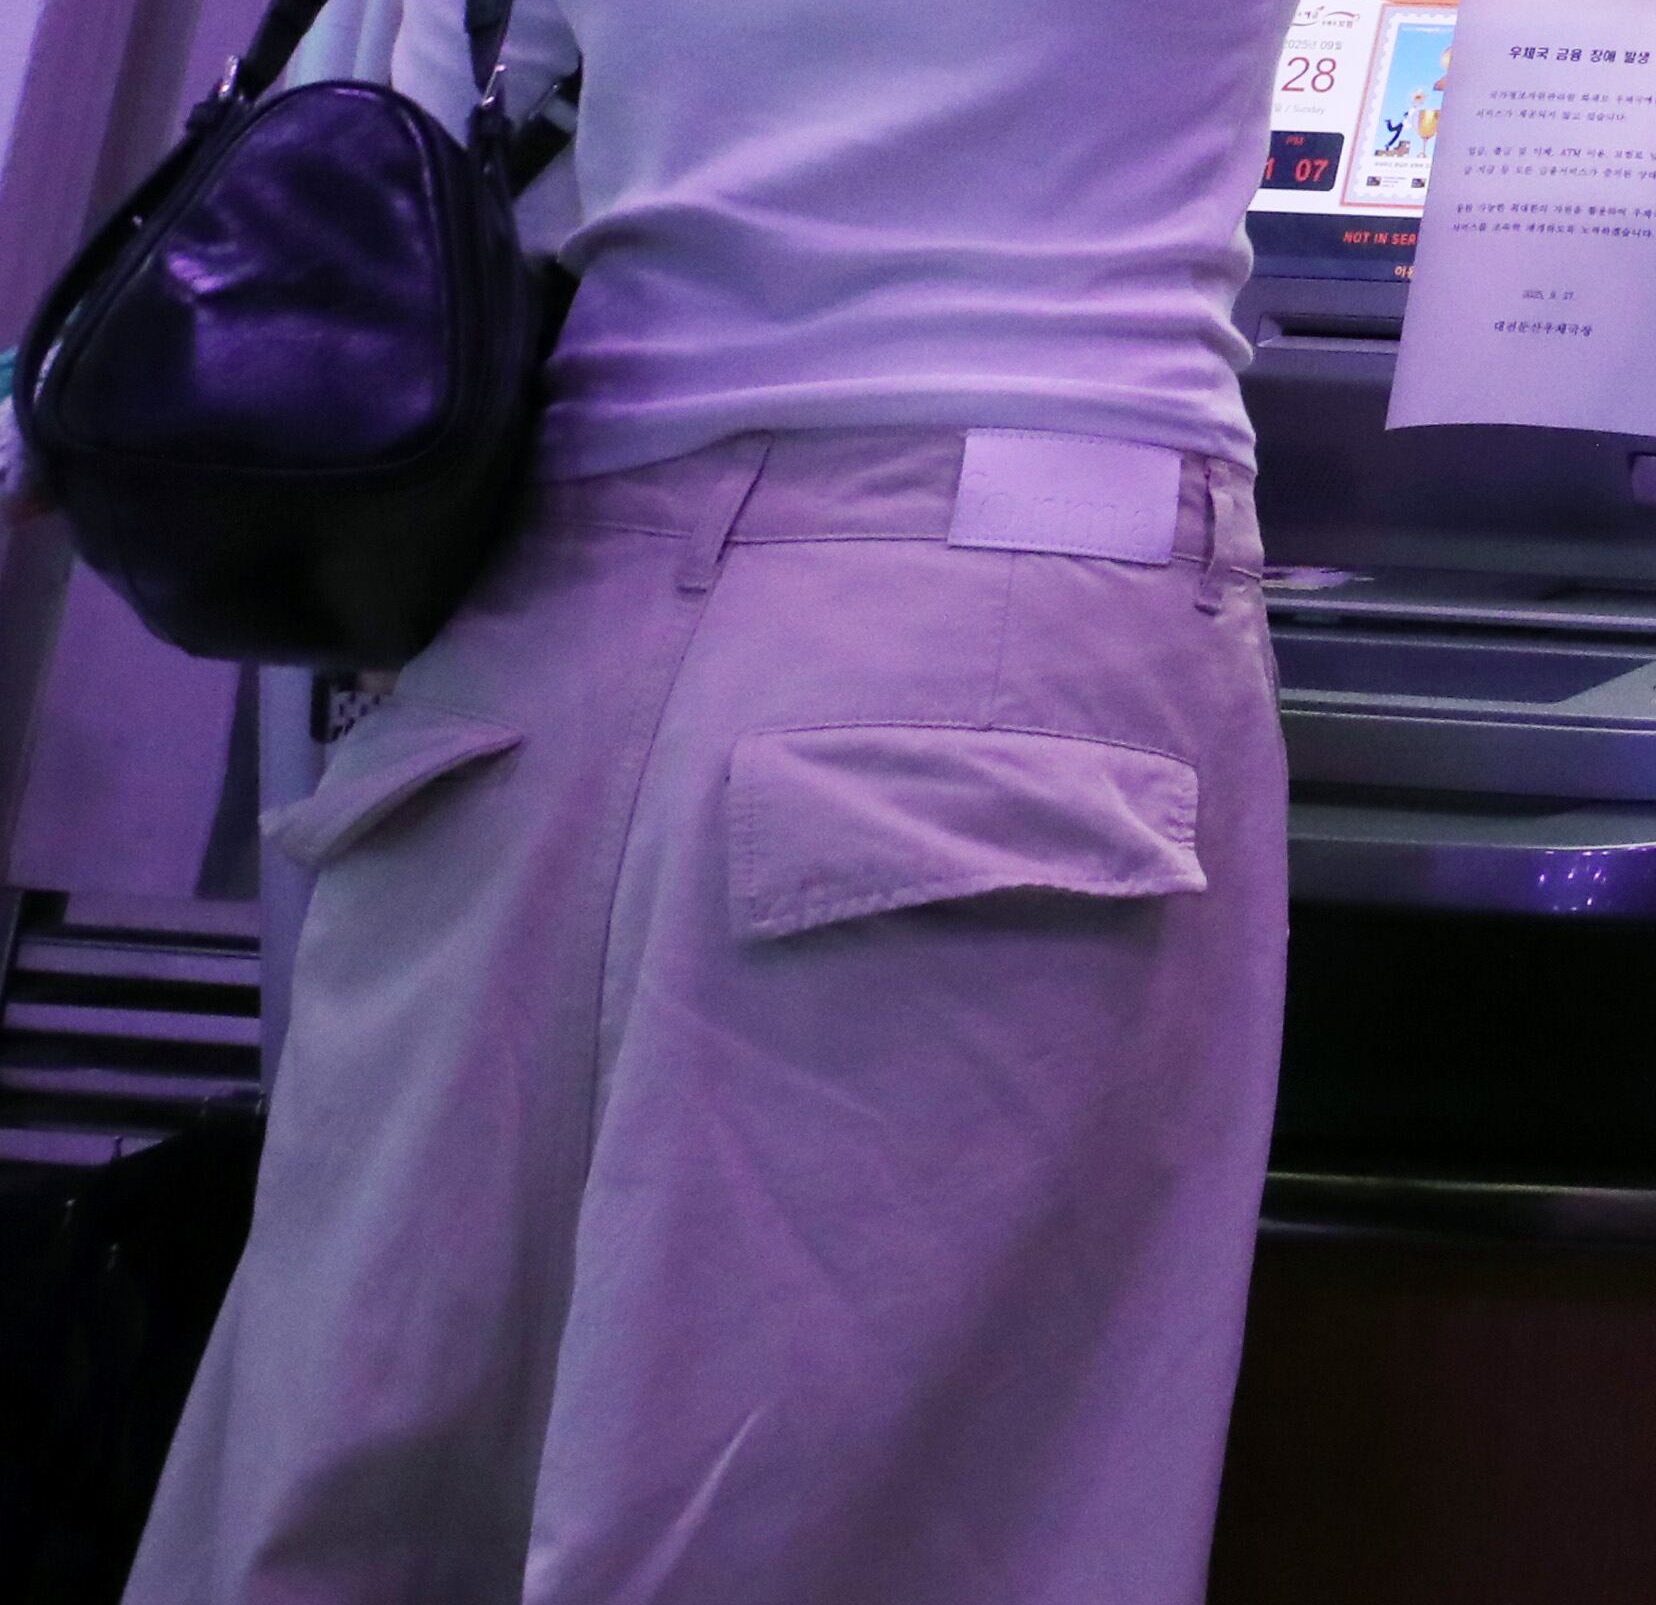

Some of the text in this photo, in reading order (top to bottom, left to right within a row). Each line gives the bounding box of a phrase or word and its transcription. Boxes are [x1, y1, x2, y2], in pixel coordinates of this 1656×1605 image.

[1509, 46, 1549, 60] 우체국
[1556, 48, 1582, 62] 금융
[1590, 49, 1616, 63] 장애
[1623, 51, 1650, 64] 발생
[1282, 57, 1336, 92] 28
[1343, 231, 1370, 243] NOT
[1375, 233, 1387, 244] IN
